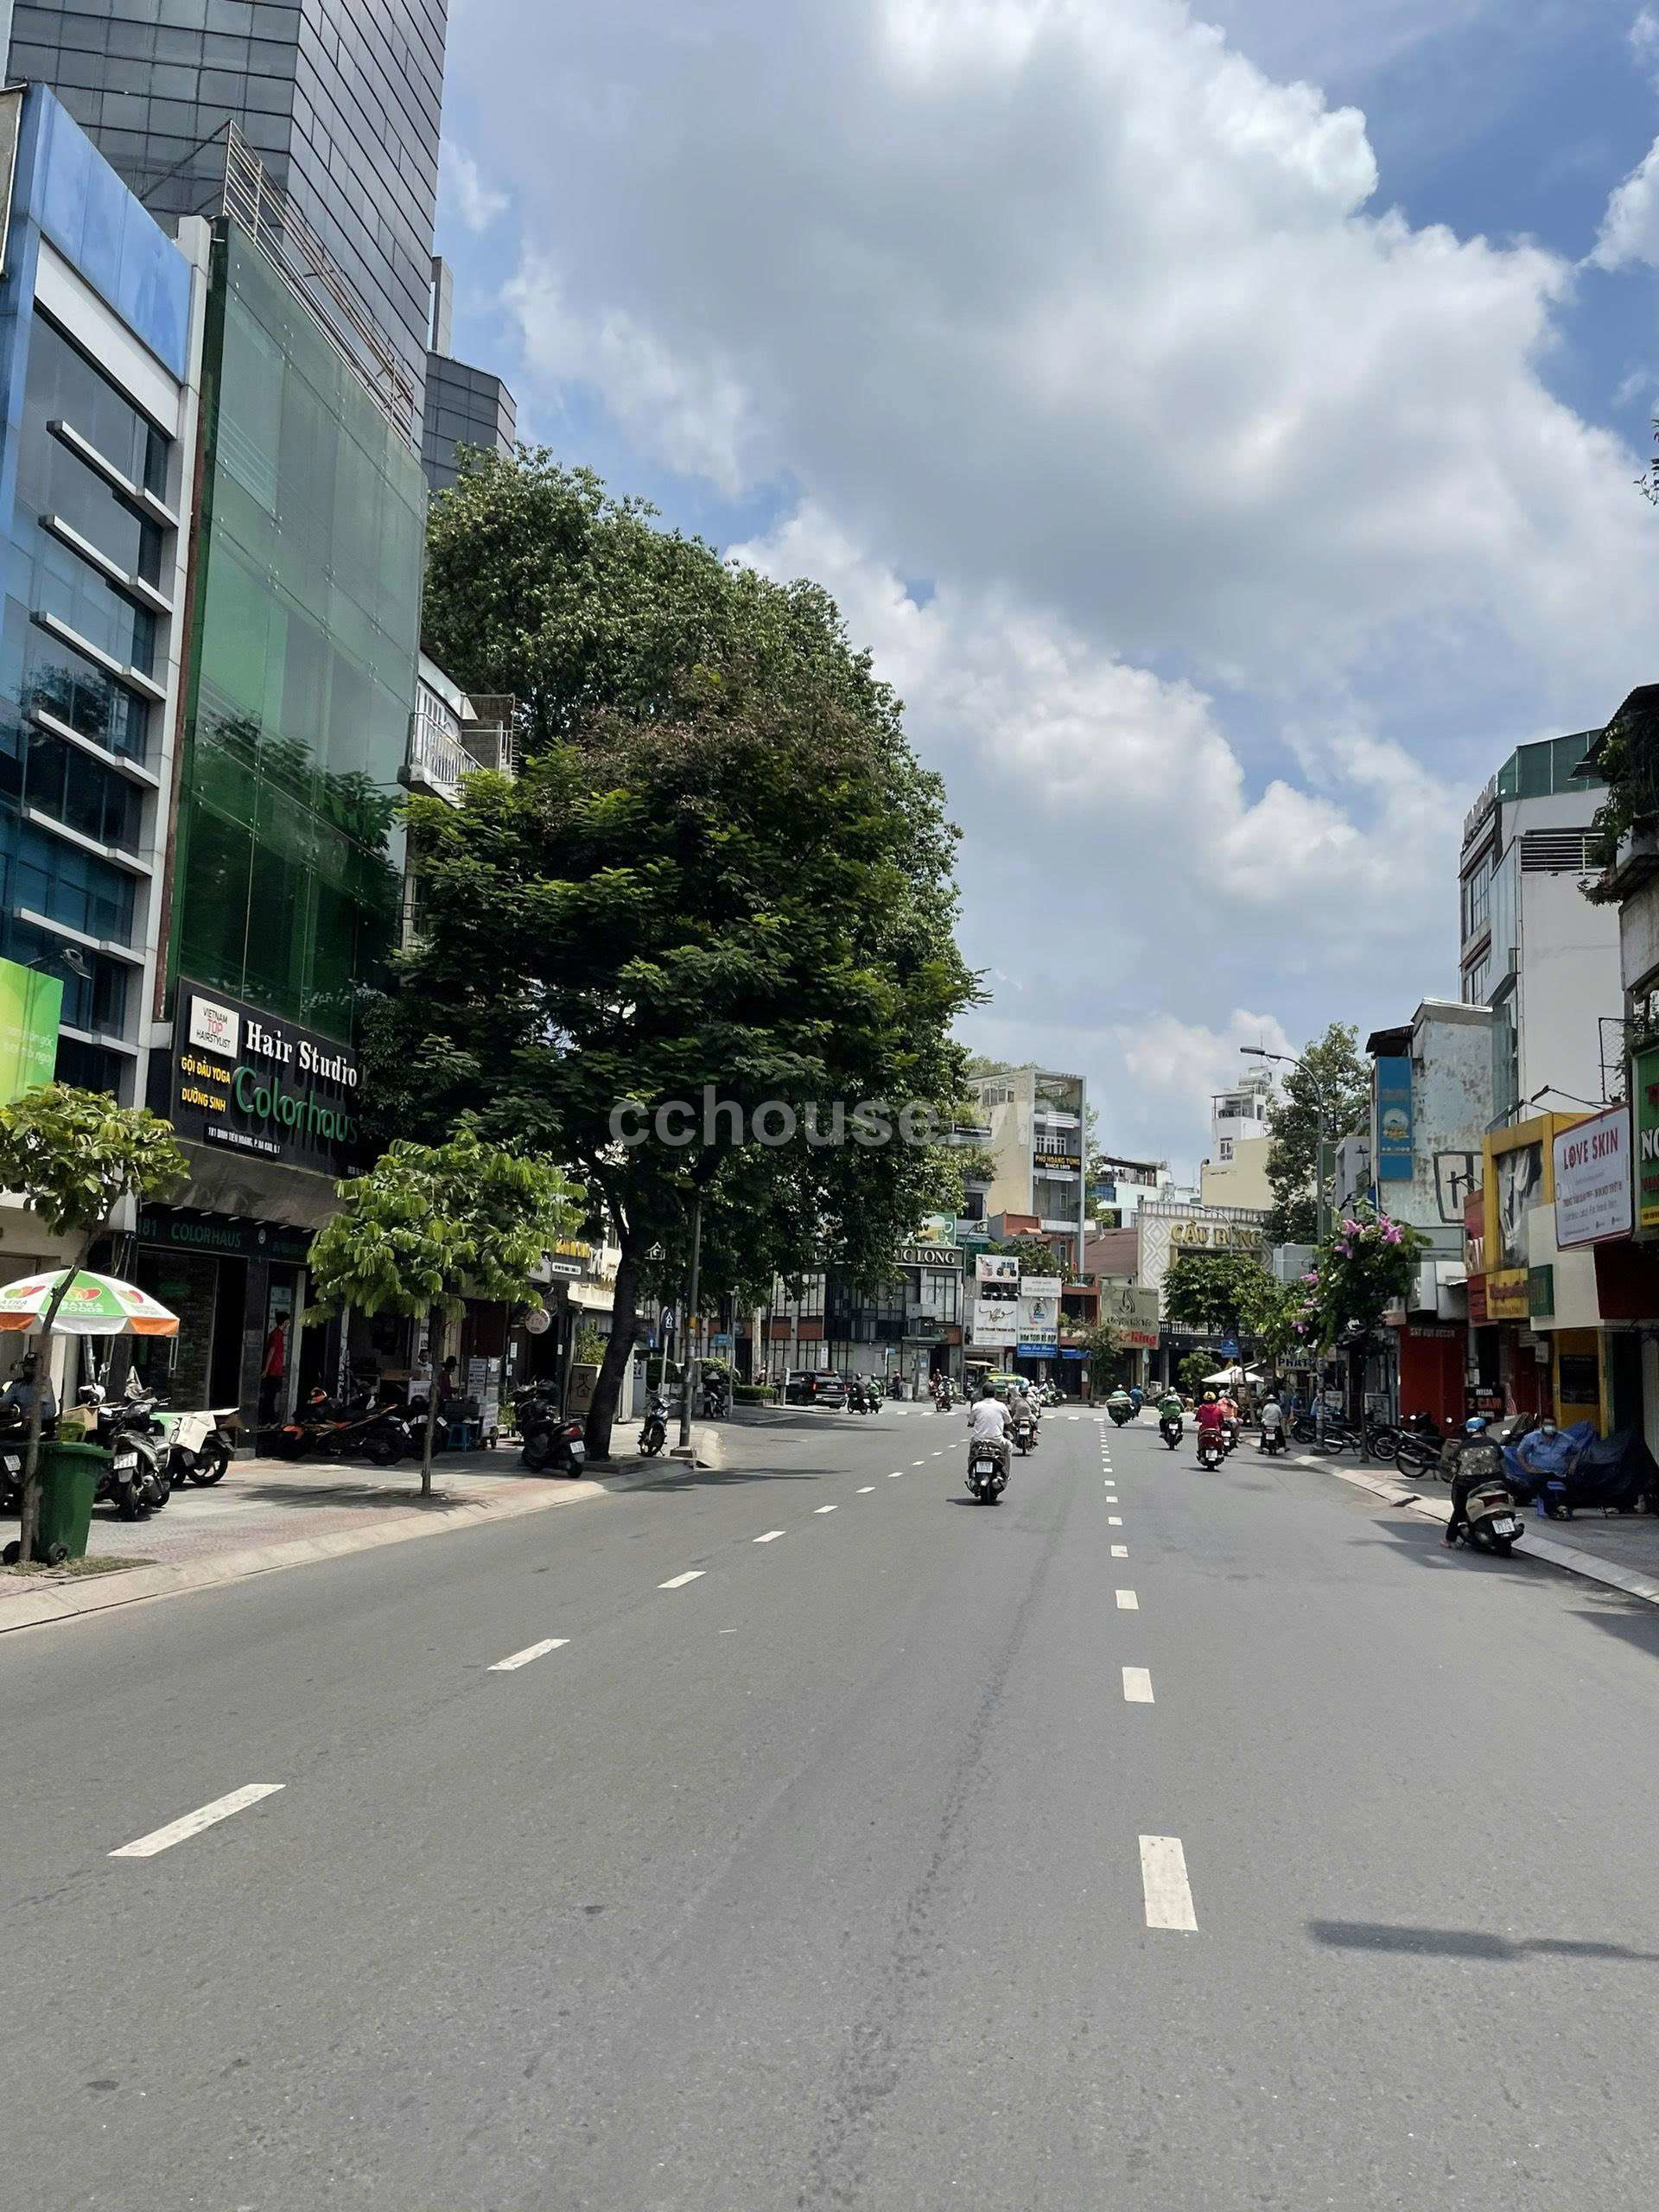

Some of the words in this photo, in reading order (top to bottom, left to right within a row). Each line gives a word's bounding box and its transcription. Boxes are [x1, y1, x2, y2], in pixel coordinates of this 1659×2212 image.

[202, 1007, 228, 1024] VIETNAM
[207, 1018, 223, 1035] TOP
[196, 1030, 231, 1049] HAIRSTYLIST
[245, 1020, 293, 1064] Hair
[298, 1040, 358, 1087] Studio
[181, 1054, 195, 1076] GỘI
[197, 1056, 211, 1077] ĐẦU
[213, 1067, 231, 1084] YOGA
[208, 1096, 226, 1113] SINH
[233, 1065, 358, 1144] Colorhaus
[1562, 1139, 1588, 1171] LOVE
[1592, 1127, 1618, 1160] SKIN
[171, 1222, 242, 1249] COLORHAUS
[917, 1249, 955, 1264] LONG
